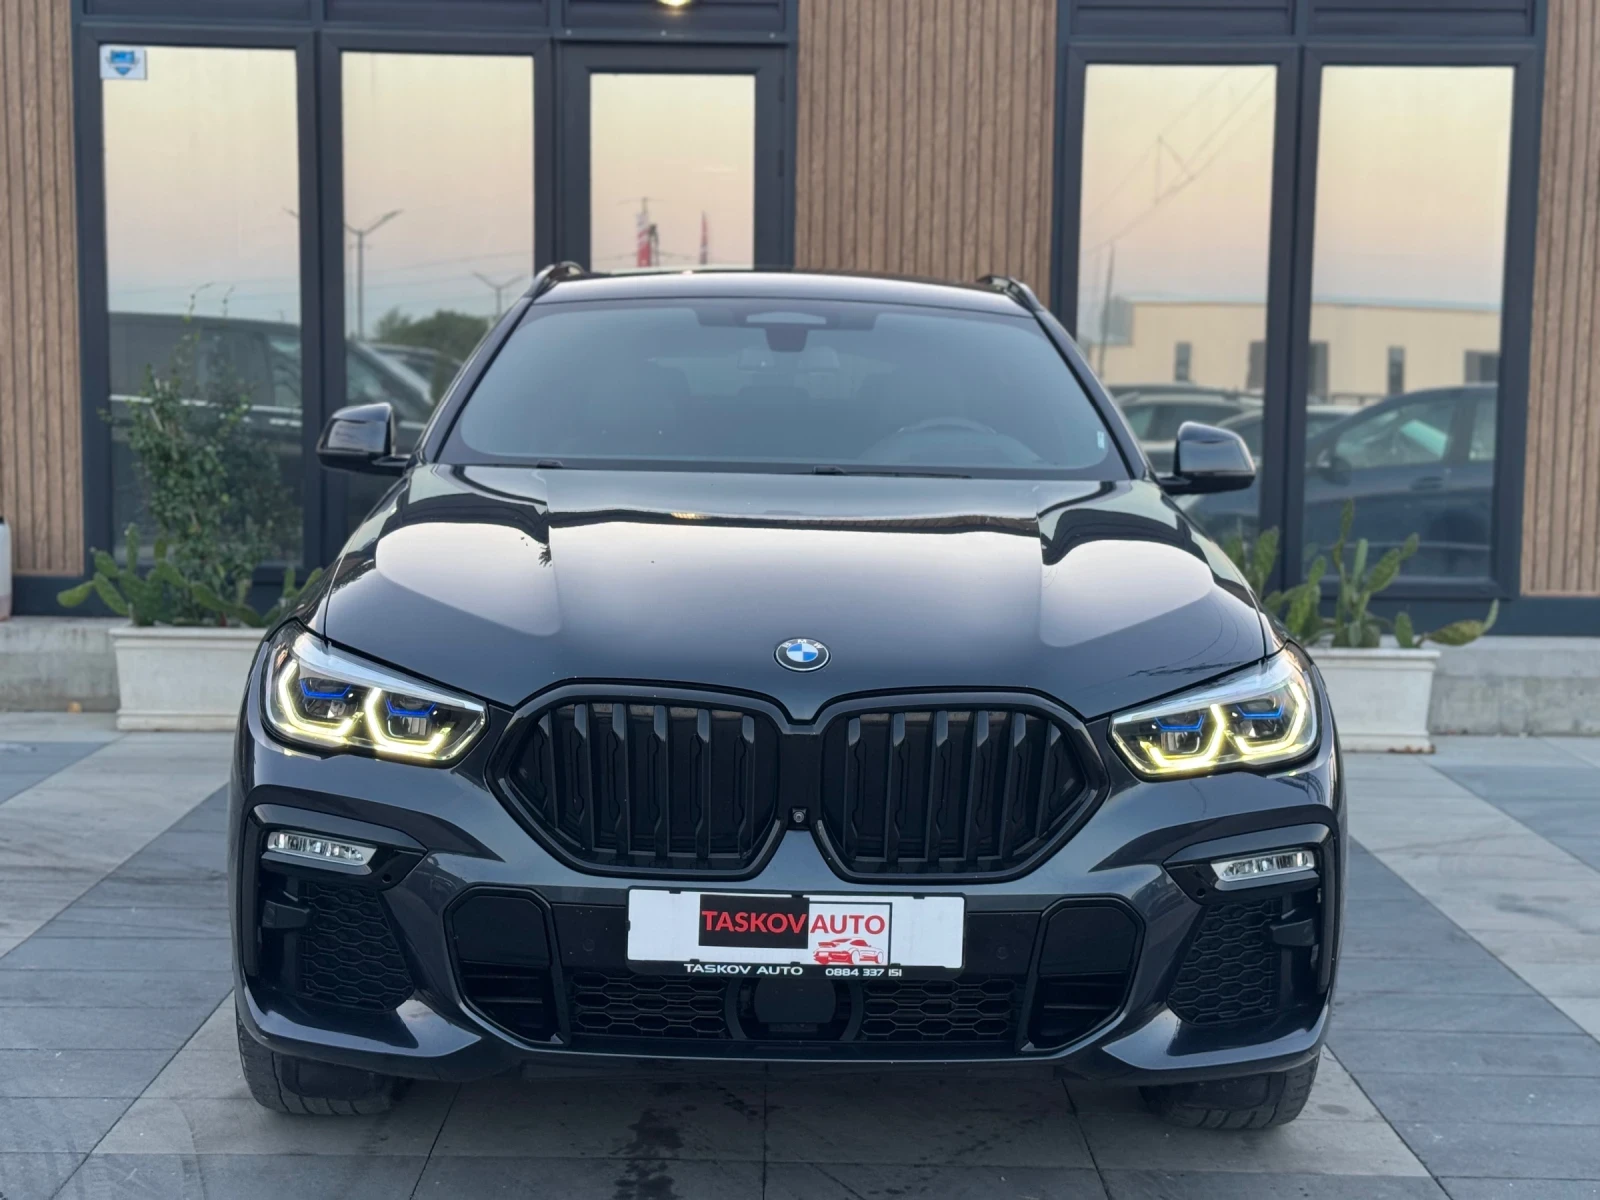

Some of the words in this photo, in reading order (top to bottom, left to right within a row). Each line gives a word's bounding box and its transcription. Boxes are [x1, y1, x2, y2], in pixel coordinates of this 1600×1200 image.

[702, 910, 807, 934] TASKOV
[810, 914, 886, 935] AUTO
[683, 963, 752, 975] TASKOV
[756, 965, 804, 976] AUTO
[825, 968, 859, 977] 0884
[862, 968, 885, 977] 337
[888, 968, 903, 977] 151
